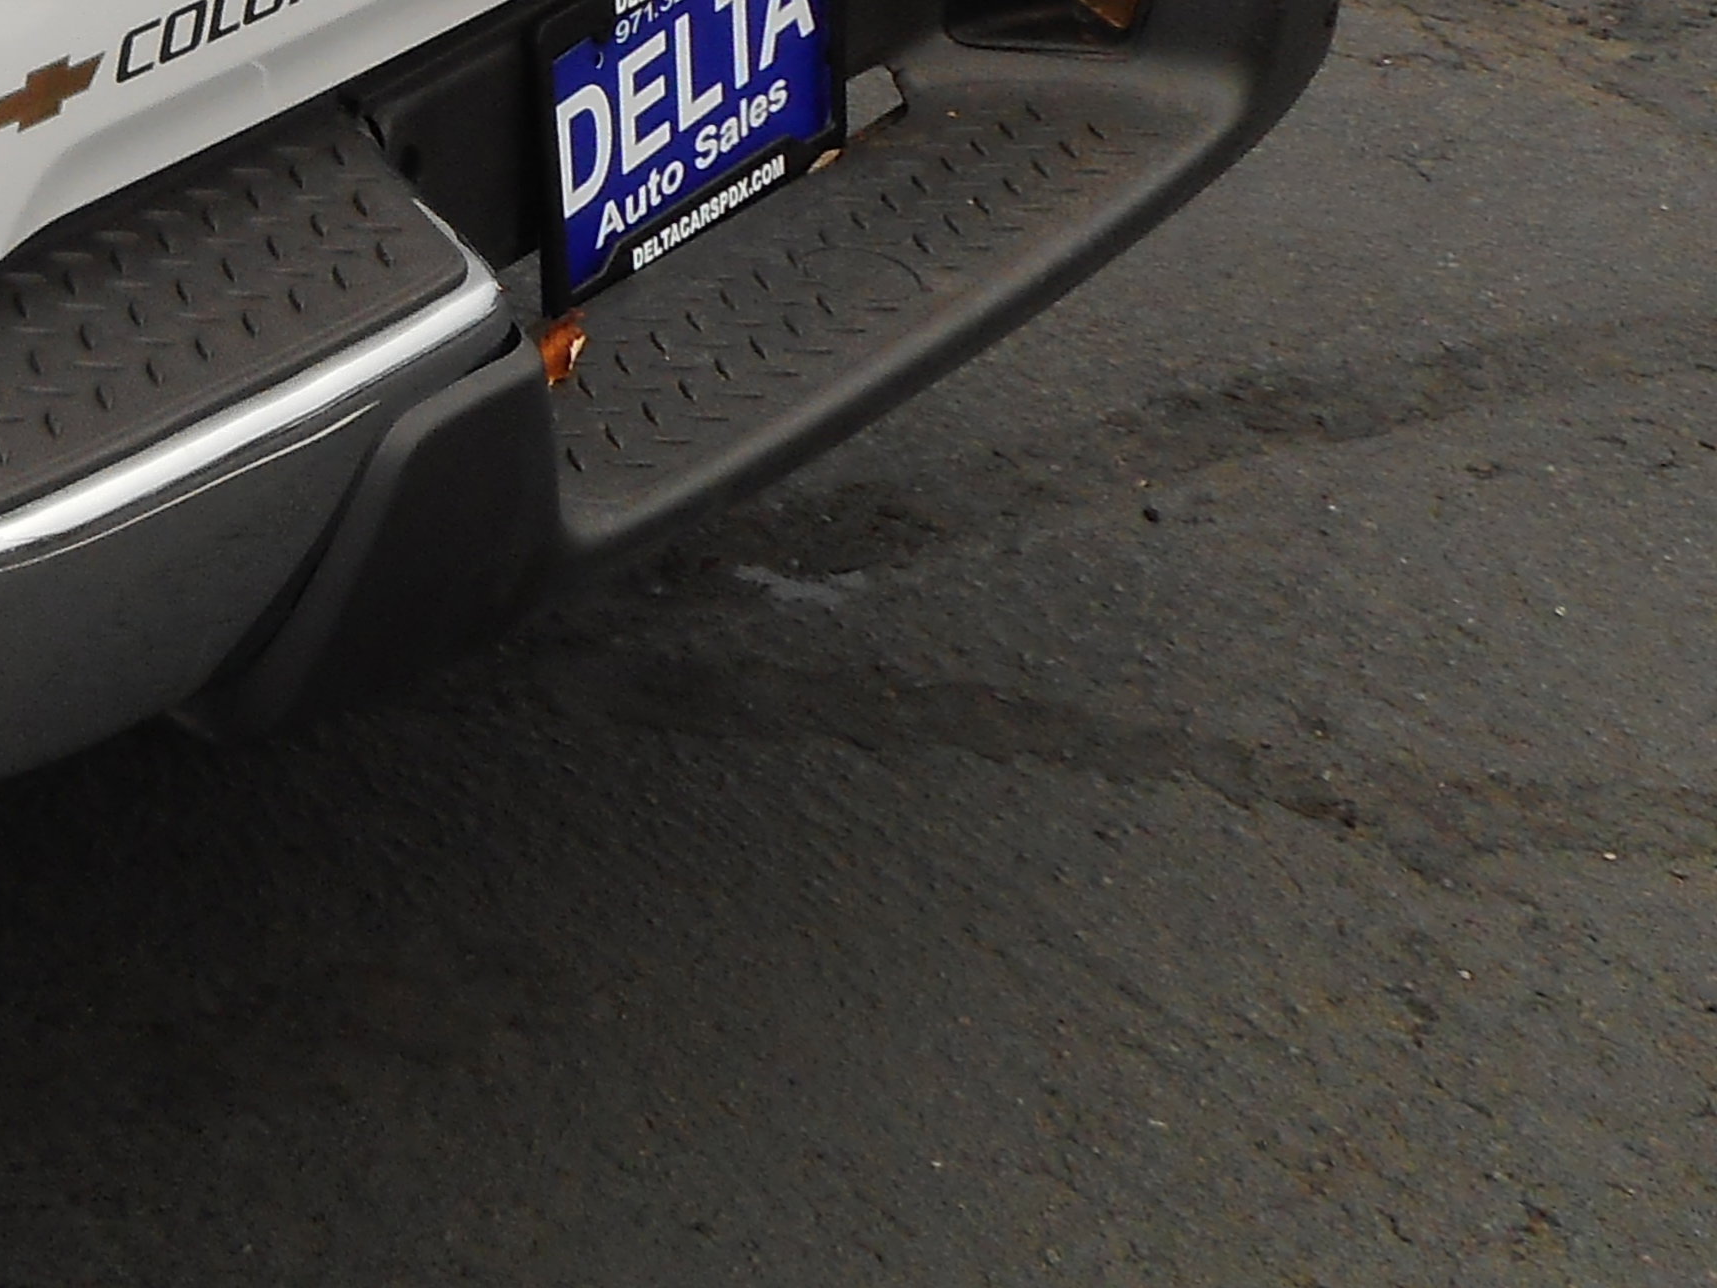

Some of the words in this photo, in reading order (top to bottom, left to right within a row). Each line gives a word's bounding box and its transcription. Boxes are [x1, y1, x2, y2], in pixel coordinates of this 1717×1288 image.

[595, 160, 684, 250] Auto
[695, 79, 788, 170] Sales
[632, 154, 786, 271] DELTACARSPDX.COM
